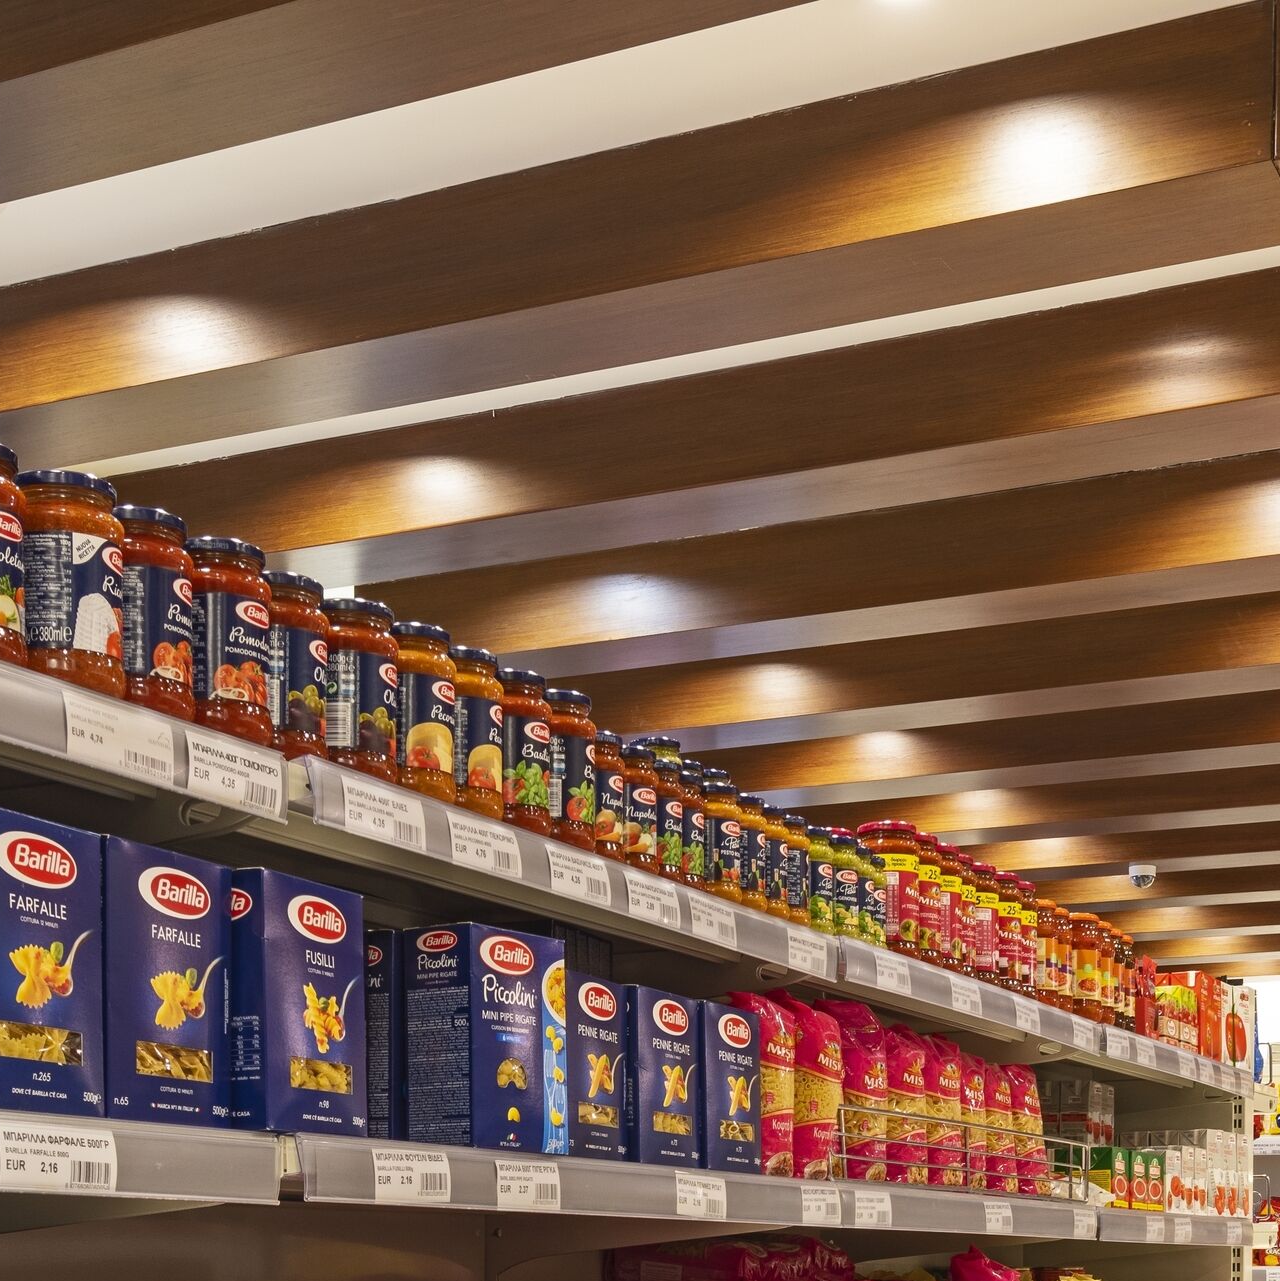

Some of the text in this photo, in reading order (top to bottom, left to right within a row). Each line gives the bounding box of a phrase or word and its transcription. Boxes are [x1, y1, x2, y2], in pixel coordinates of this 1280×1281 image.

[75, 538, 93, 555] NUOVA
[13, 844, 70, 877] Barilla
[155, 878, 205, 909] Barilla
[9, 893, 68, 921] FARFALLE
[302, 906, 342, 934] Barilla
[151, 923, 201, 949] FARFALLE
[305, 949, 335, 969] FUSILLI
[417, 954, 458, 970] Piccolini
[494, 945, 530, 967] Barilla
[481, 974, 537, 1008] Piccolini
[587, 990, 614, 1014] Barilla
[661, 1007, 688, 1028] Barilla
[577, 1024, 618, 1044] PENNE RIGATE
[726, 1022, 750, 1041] Barilla
[652, 1037, 690, 1055] PENNE RIGATE
[718, 1050, 753, 1067] PENNE RIGATE
